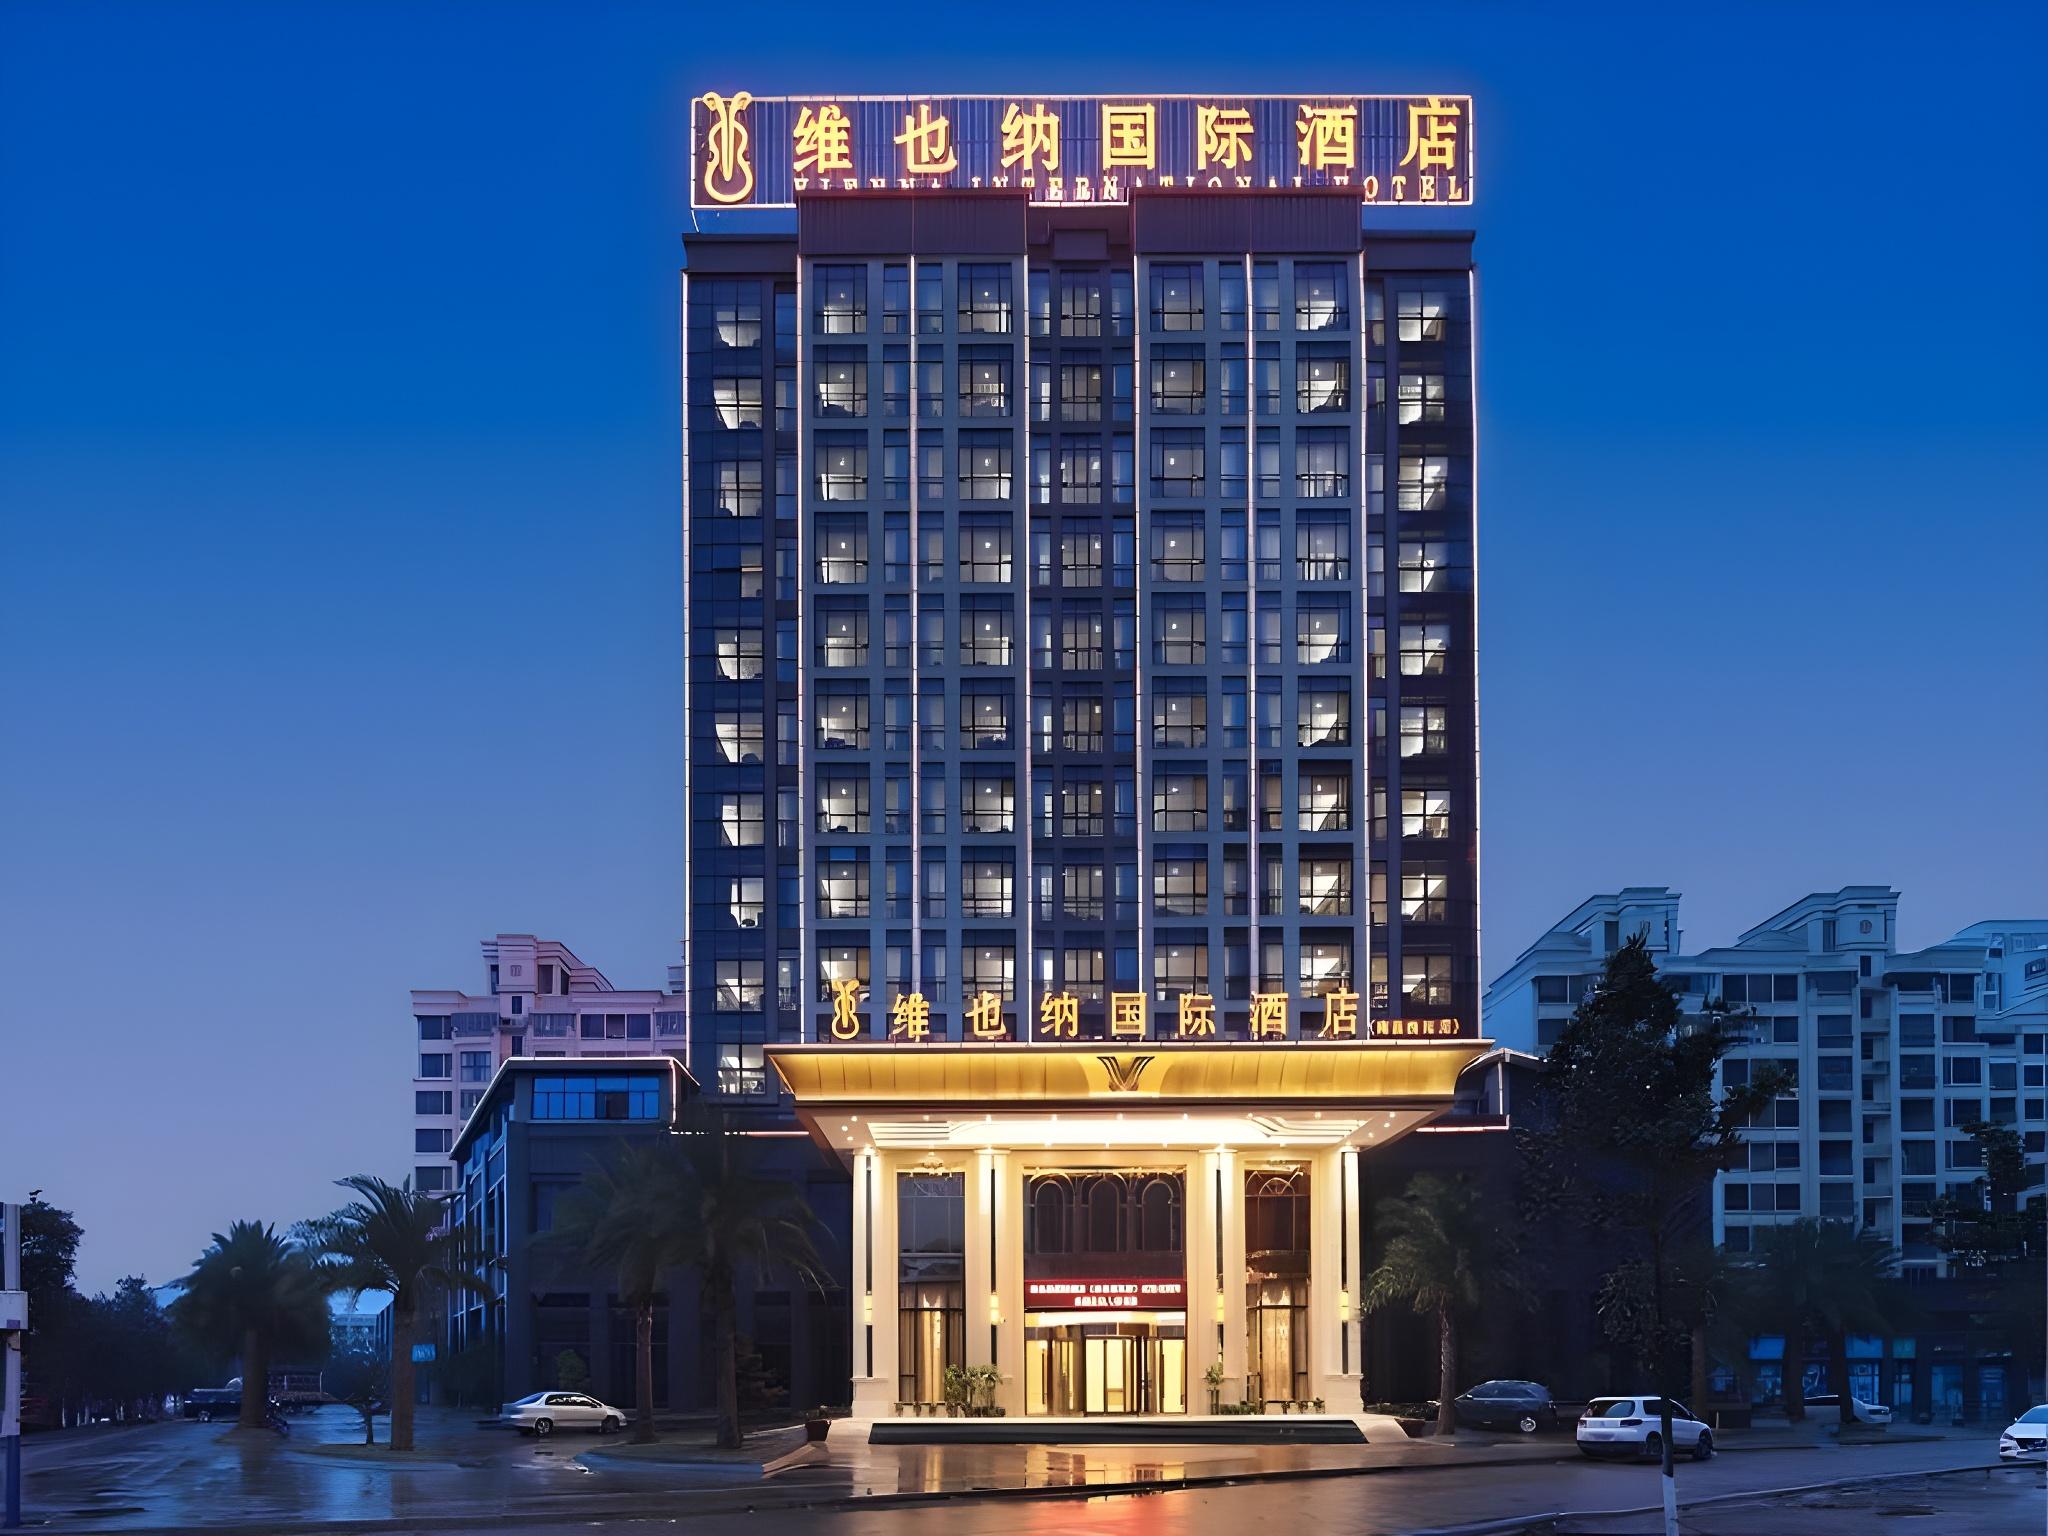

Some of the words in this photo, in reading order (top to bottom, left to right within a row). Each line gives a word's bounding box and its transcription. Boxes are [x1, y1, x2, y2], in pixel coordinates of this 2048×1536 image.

[793, 97, 1459, 174] 维也纳国际酒店
[892, 988, 1360, 1039] 维也纳国际酒店
